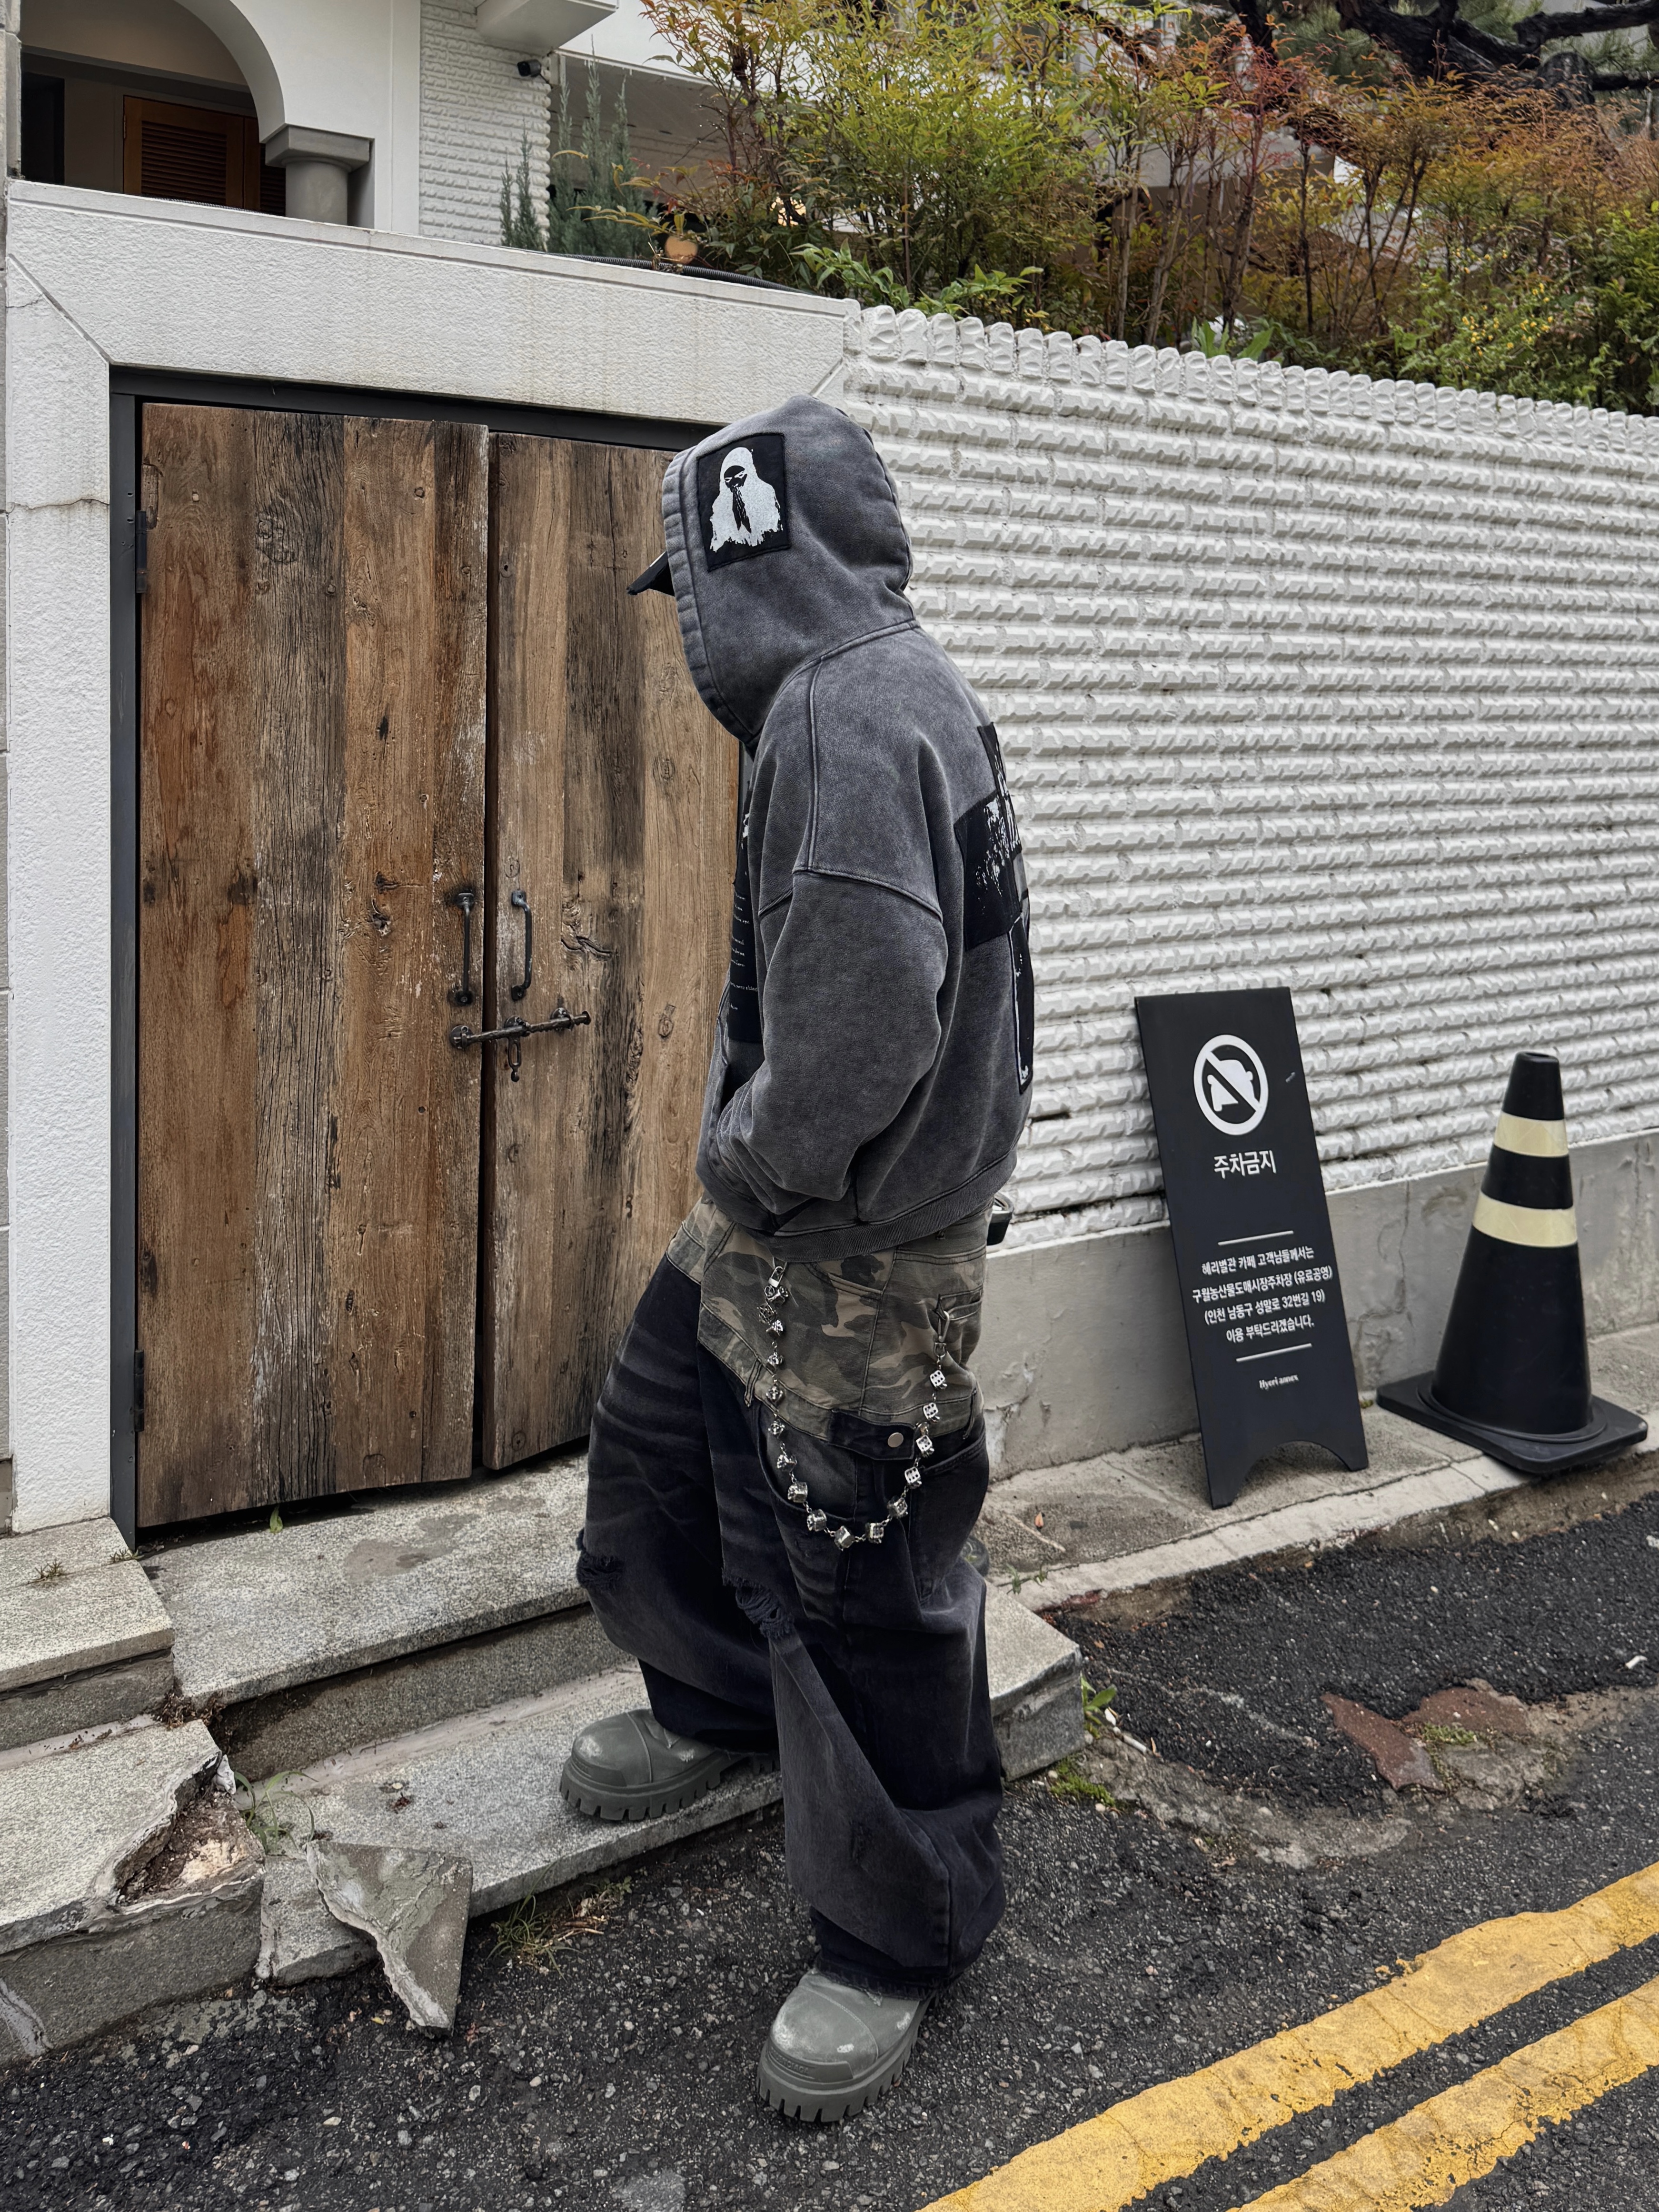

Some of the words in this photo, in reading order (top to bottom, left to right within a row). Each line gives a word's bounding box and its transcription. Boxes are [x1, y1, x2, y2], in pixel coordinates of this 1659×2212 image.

[1214, 1150, 1276, 1179] 주차금지
[1238, 1255, 1256, 1269] 카페
[1258, 1246, 1314, 1265] 고객님들께서는
[1294, 1265, 1332, 1285] (유료공영)
[1205, 1308, 1226, 1325] (인천
[1227, 1303, 1253, 1320] 남동구
[1255, 1298, 1281, 1315] 성말로
[1282, 1292, 1310, 1308] 32번길
[1311, 1289, 1325, 1302] 19)
[1226, 1328, 1243, 1343] 이용
